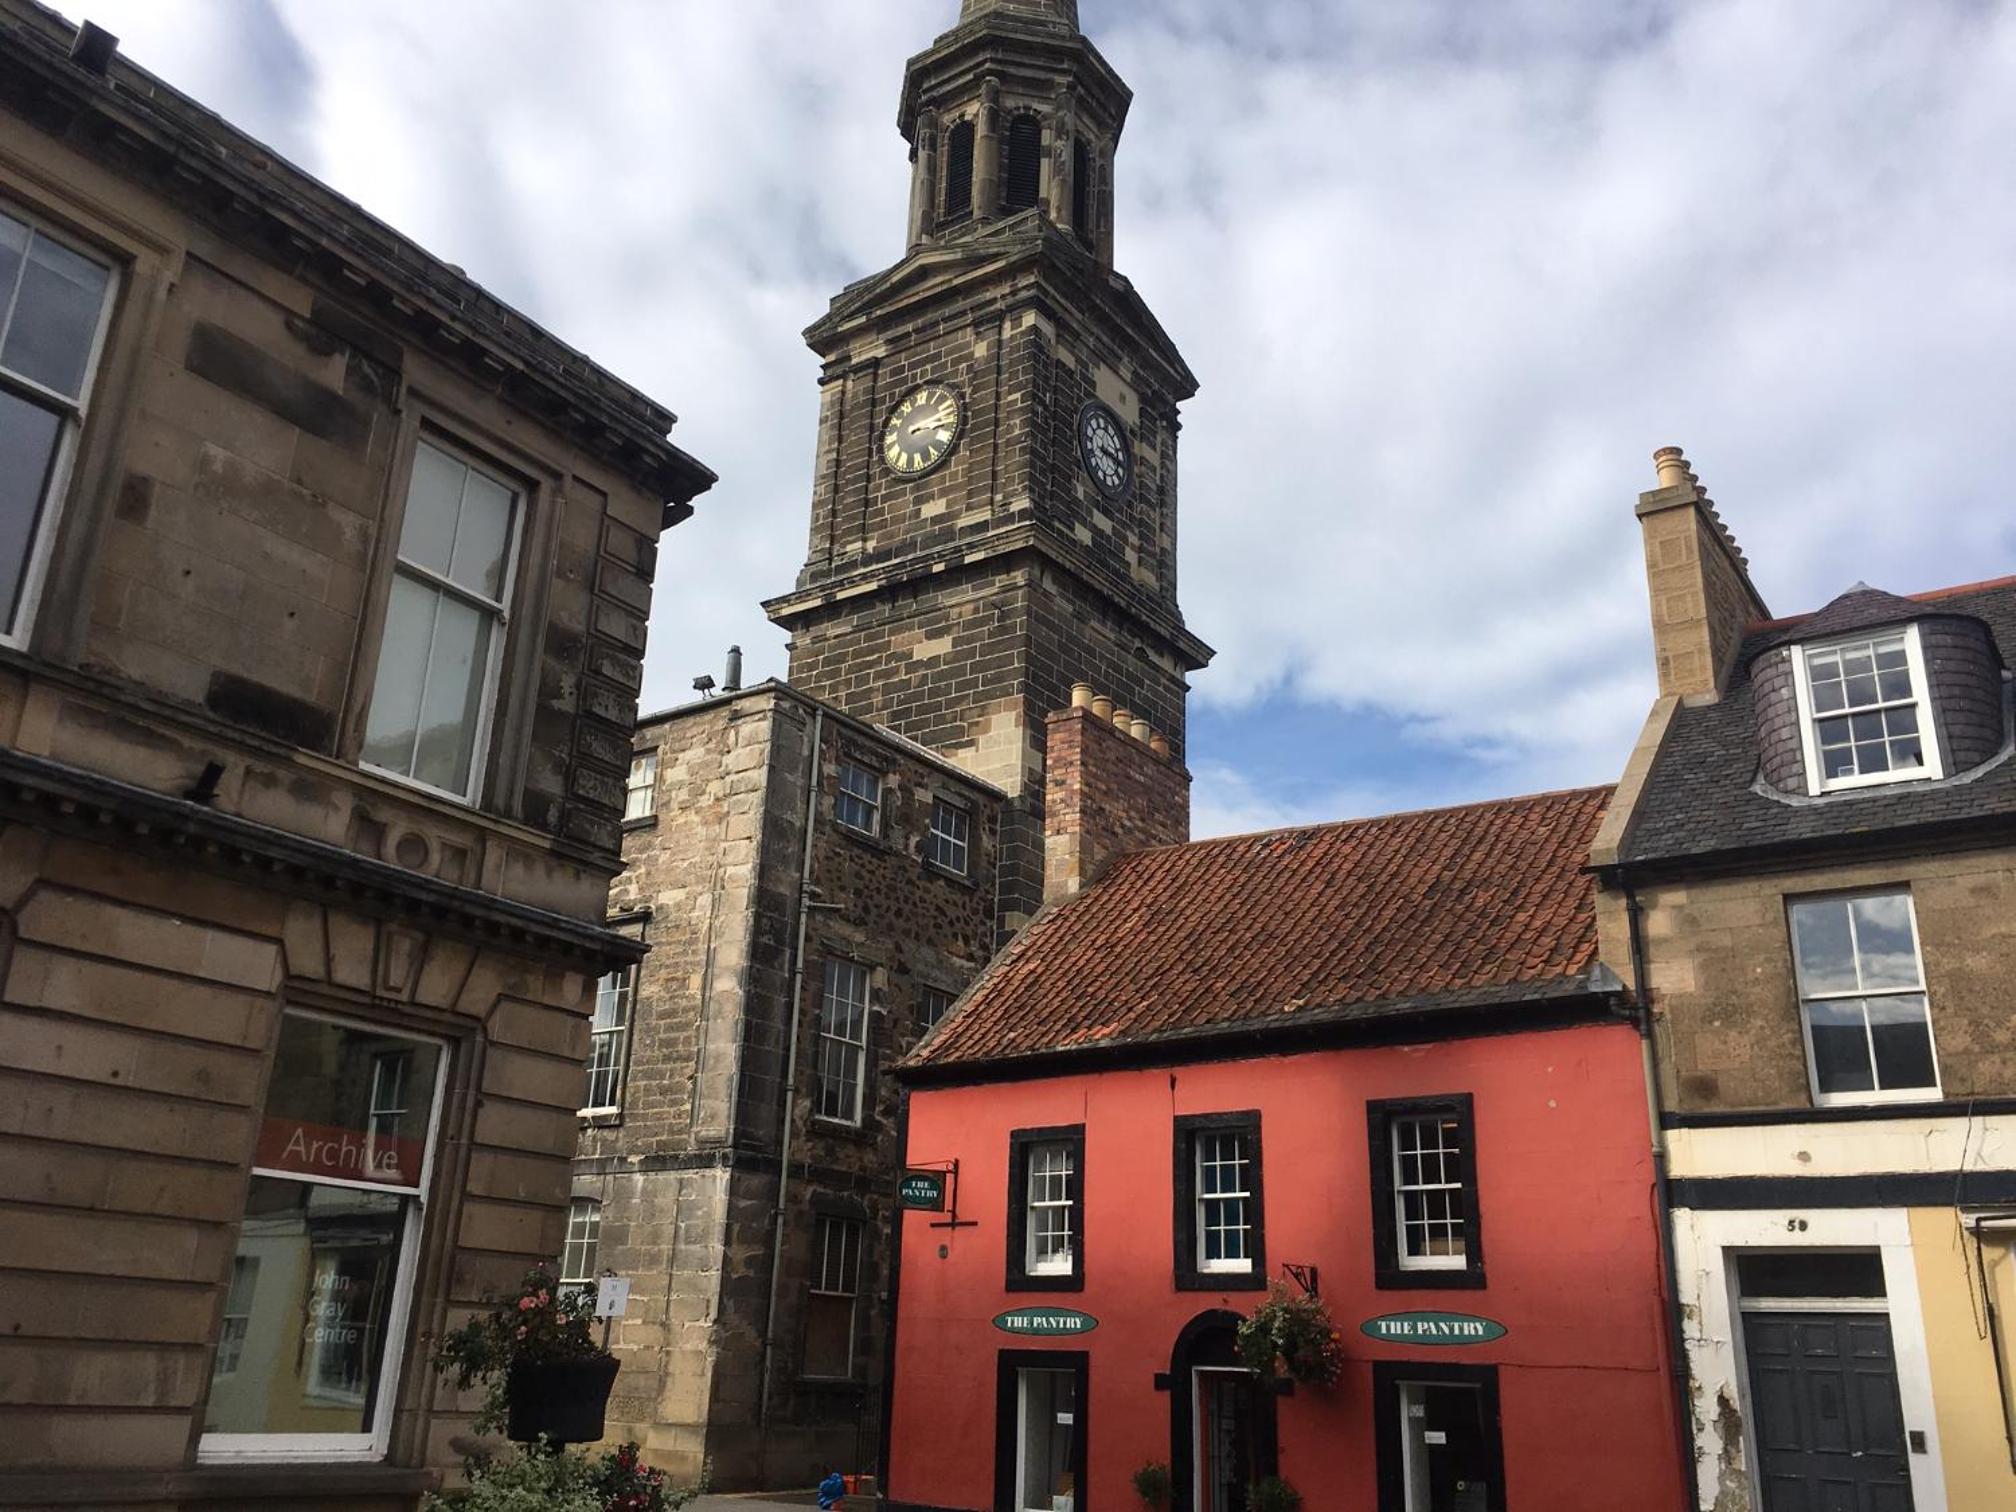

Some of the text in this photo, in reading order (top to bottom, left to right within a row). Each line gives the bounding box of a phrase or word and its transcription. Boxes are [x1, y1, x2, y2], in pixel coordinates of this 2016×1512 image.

[281, 1127, 399, 1174] Archive
[902, 1188, 938, 1198] PANTRY
[912, 1180, 931, 1188] THE
[311, 1269, 352, 1291] John
[309, 1296, 347, 1322] Gray
[1005, 1316, 1083, 1329] THE PANTRY
[1377, 1321, 1486, 1336] THE PANTRY
[304, 1322, 359, 1344] Centre
